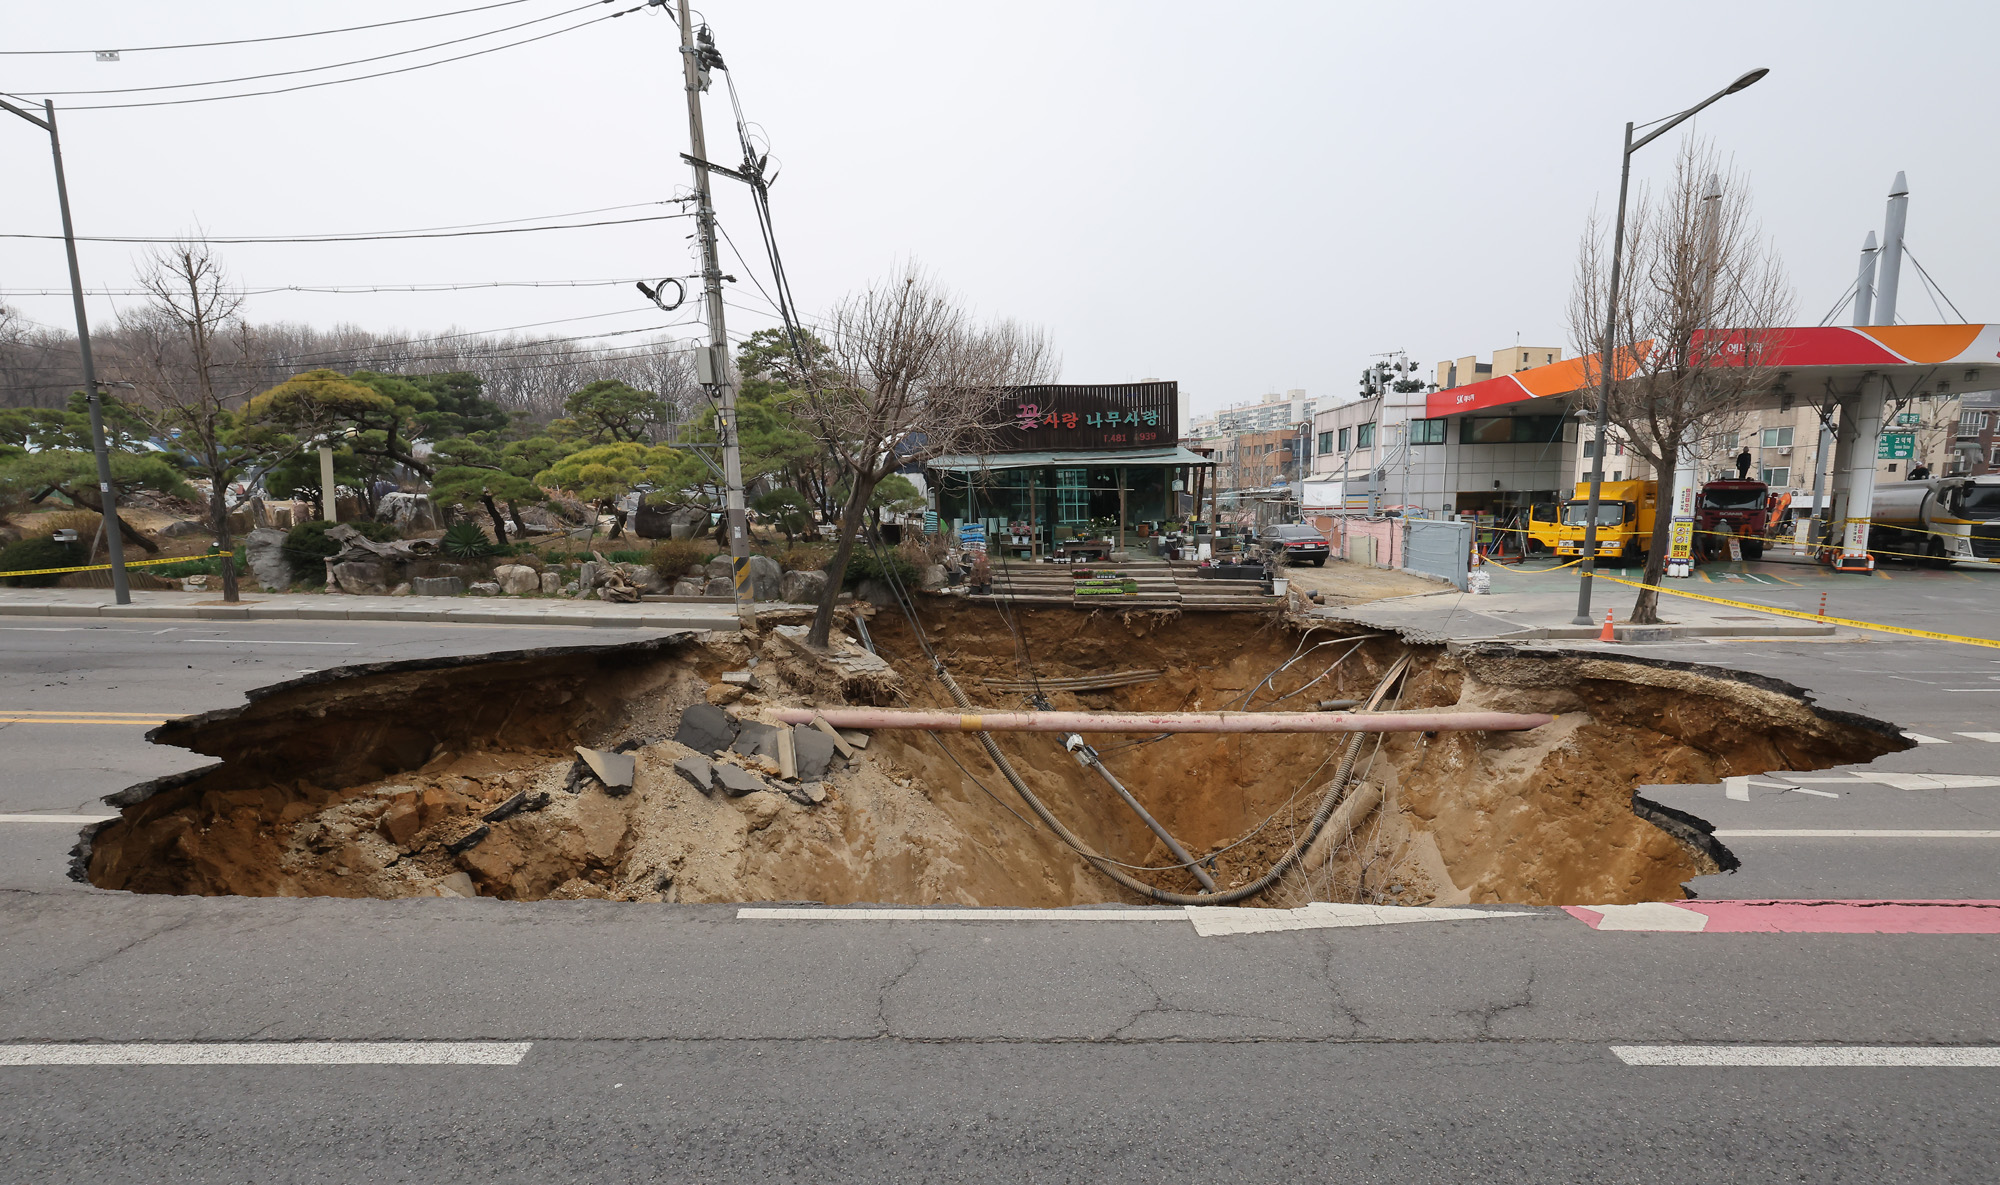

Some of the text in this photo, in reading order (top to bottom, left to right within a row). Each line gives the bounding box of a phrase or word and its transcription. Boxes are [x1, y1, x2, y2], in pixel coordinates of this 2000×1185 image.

[1016, 404, 1159, 430] 꽃사랑 나무사랑
[1134, 432, 1157, 441] 939
